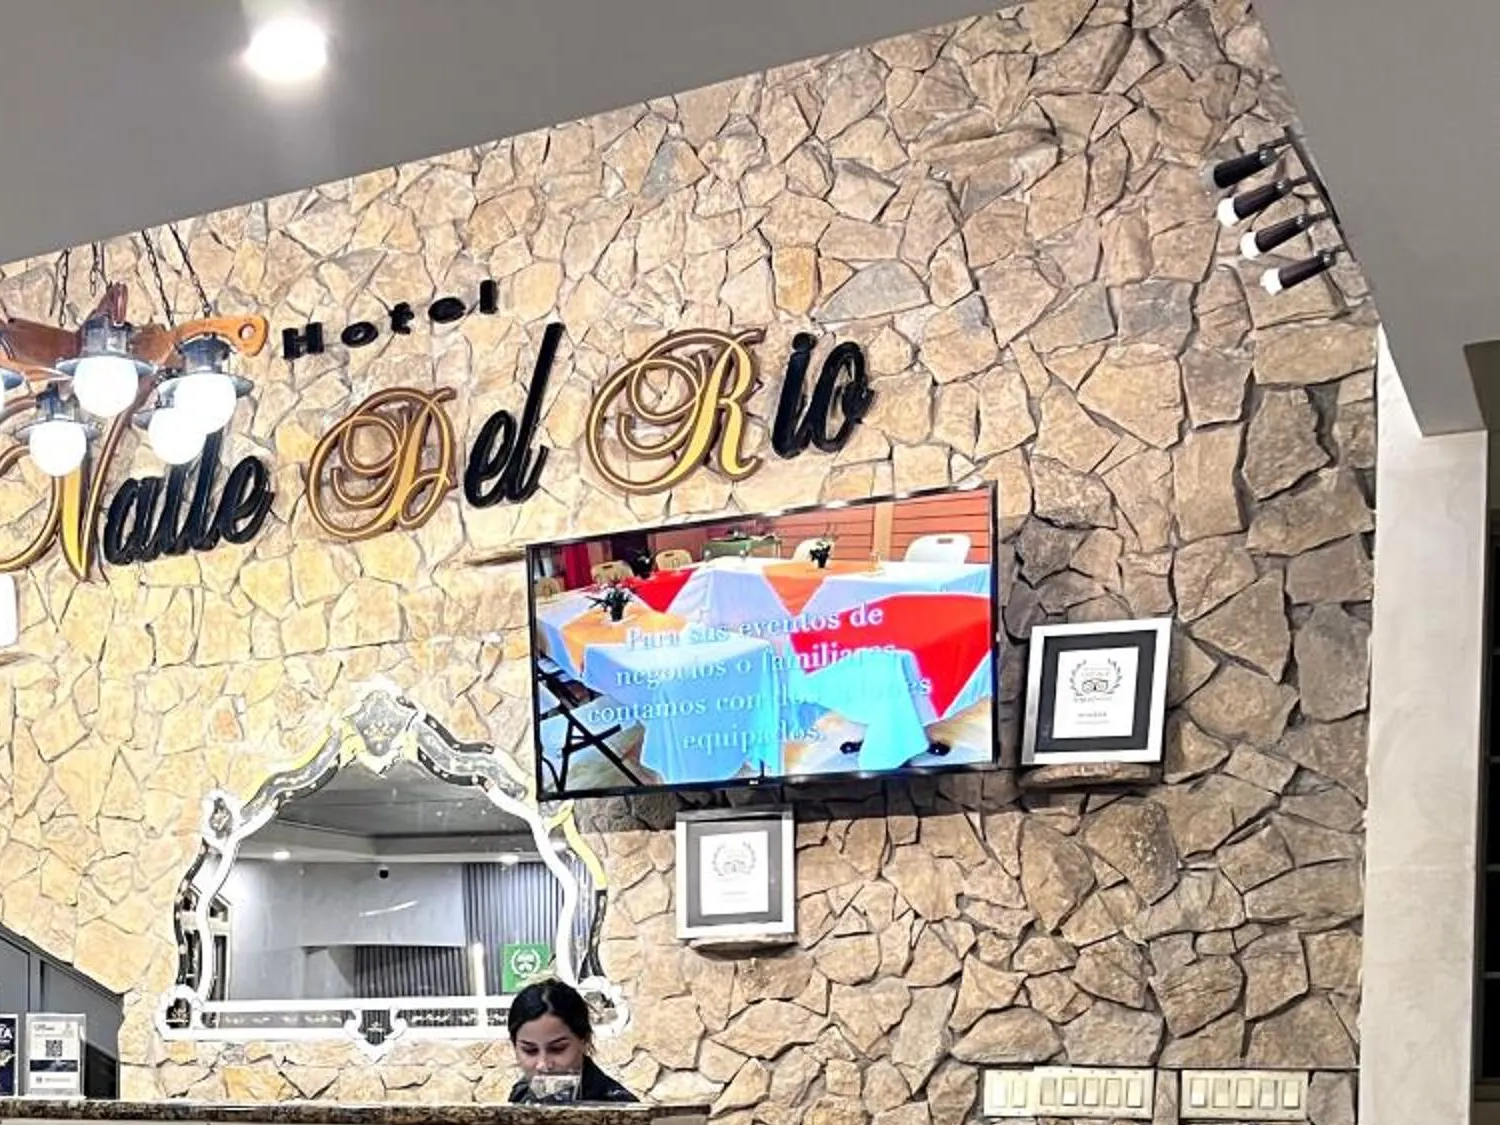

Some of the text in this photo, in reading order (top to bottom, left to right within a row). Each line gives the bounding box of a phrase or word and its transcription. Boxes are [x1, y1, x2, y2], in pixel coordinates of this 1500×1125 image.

[282, 279, 499, 360] Hotel
[307, 321, 567, 542] Del
[585, 328, 875, 494] Rio
[629, 602, 885, 650] Para sus eventos de
[615, 659, 727, 688] negocios
[737, 659, 751, 674] o
[588, 695, 762, 722] contamos con
